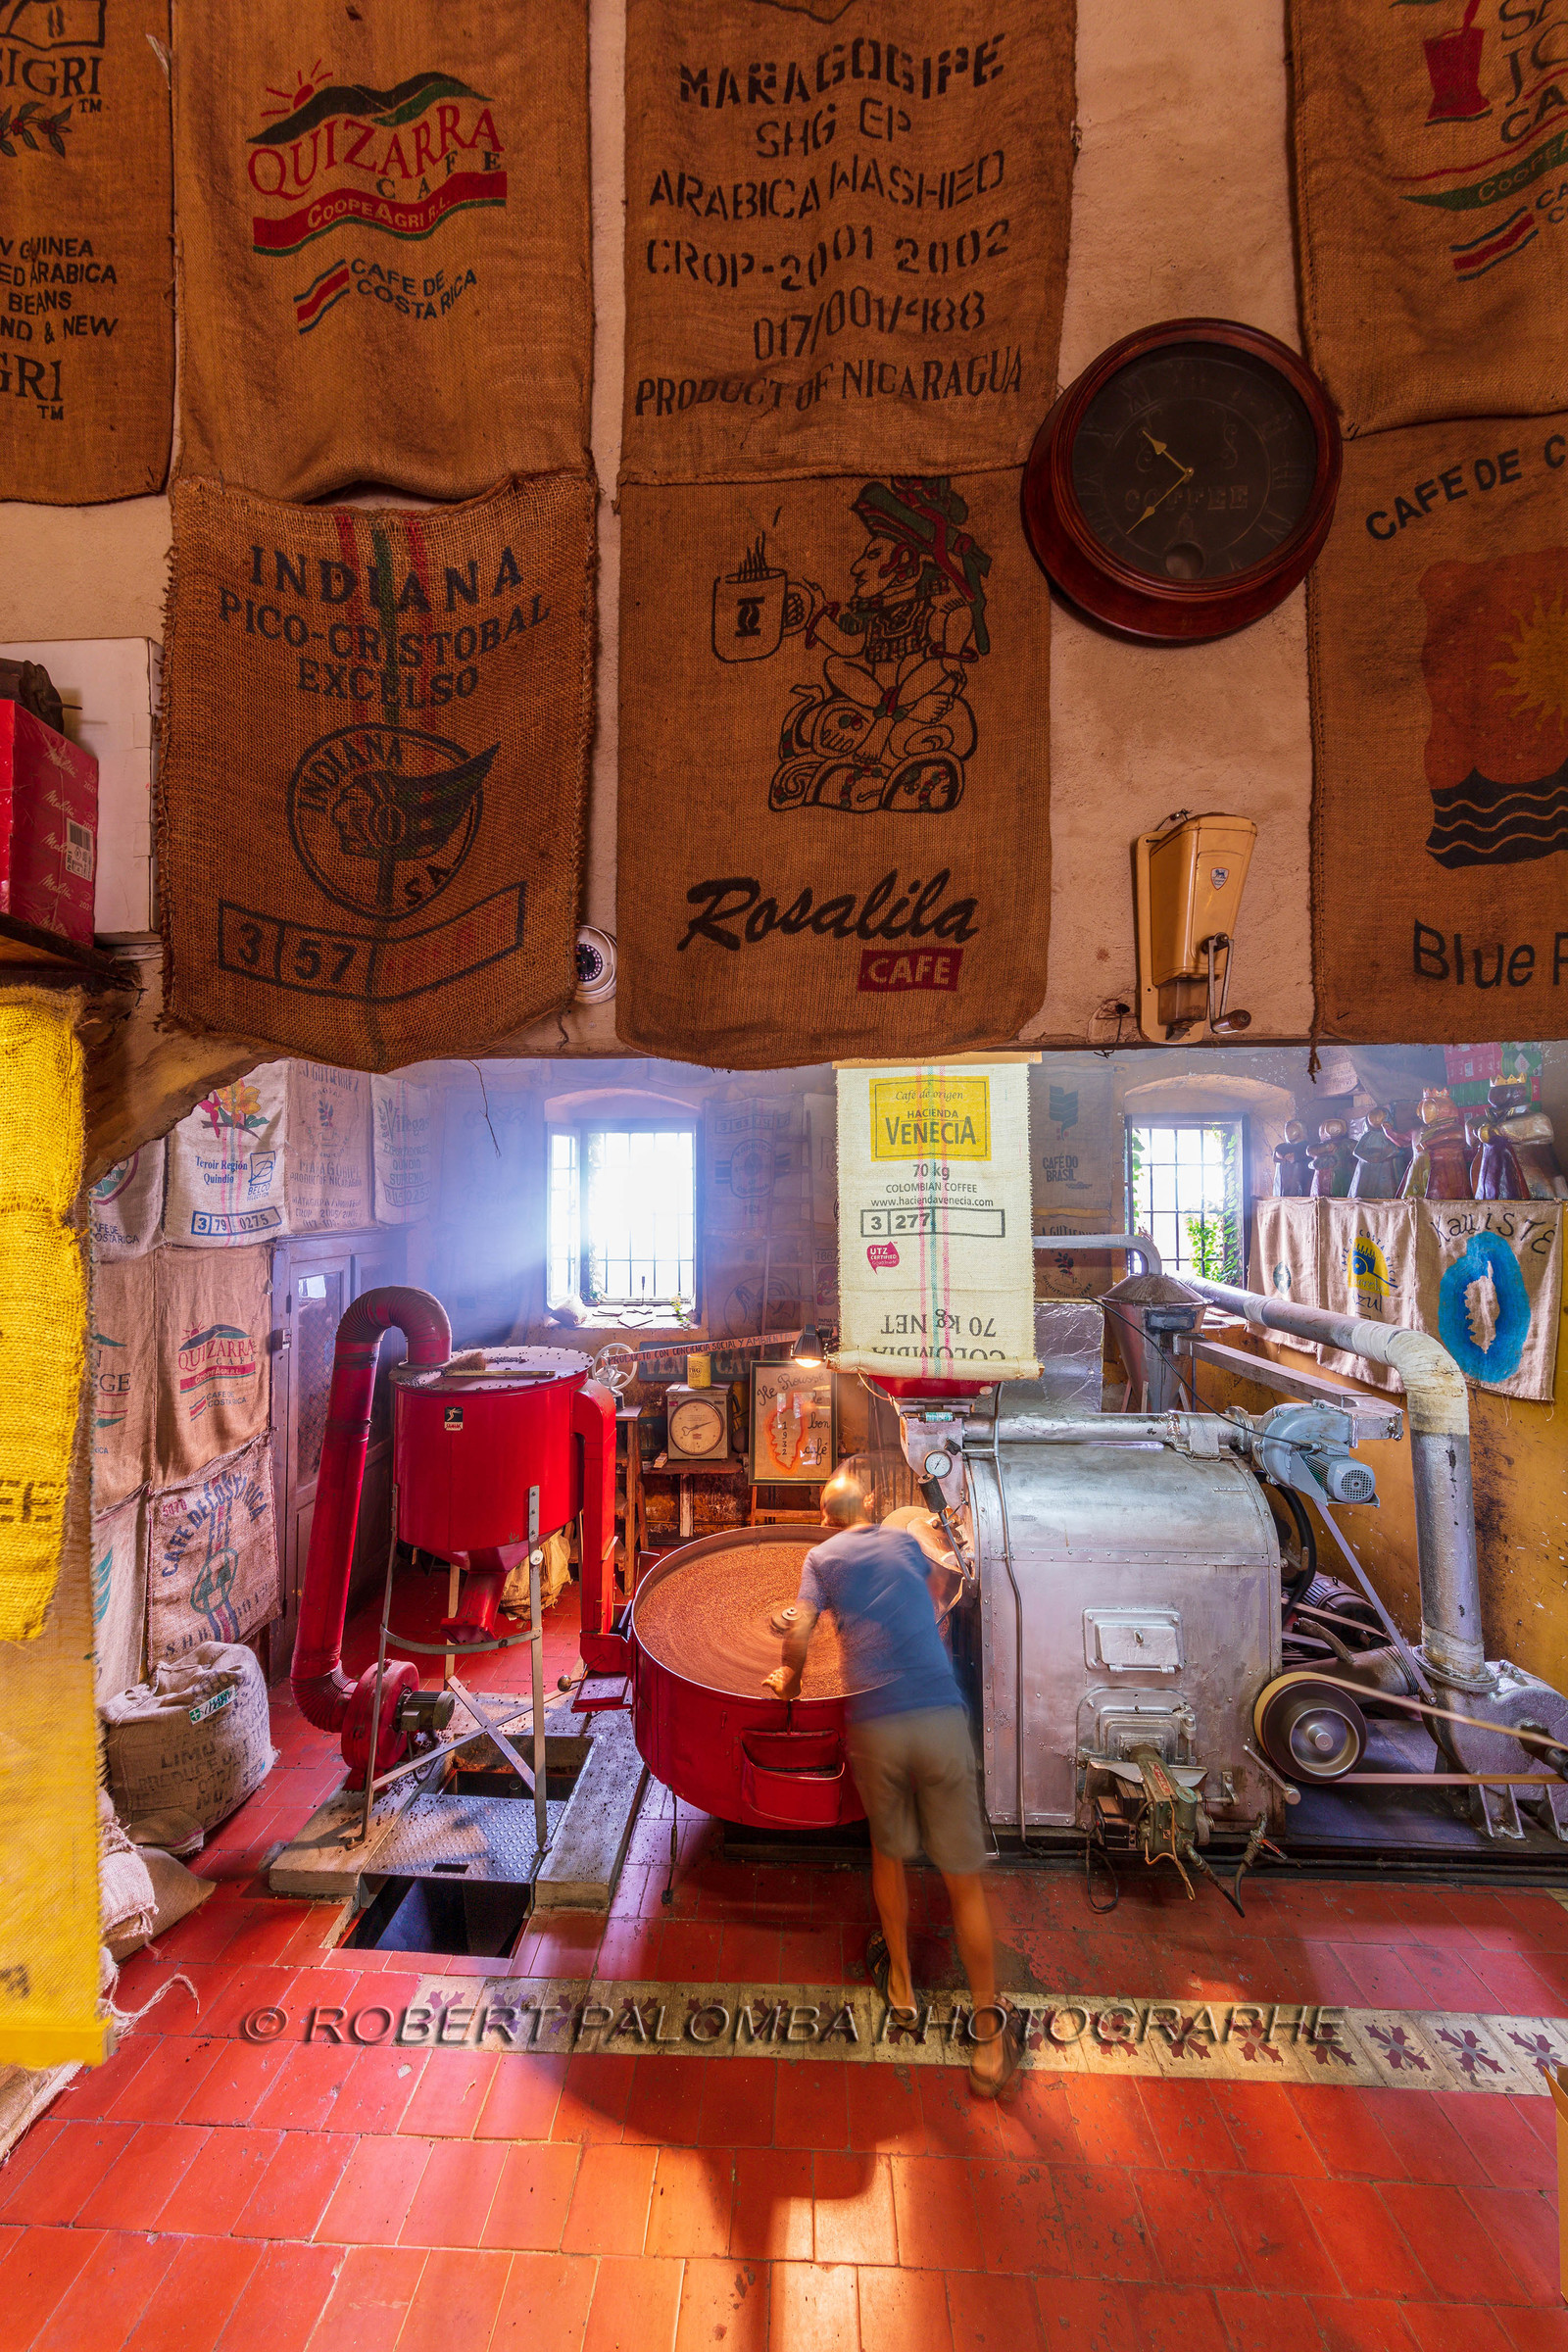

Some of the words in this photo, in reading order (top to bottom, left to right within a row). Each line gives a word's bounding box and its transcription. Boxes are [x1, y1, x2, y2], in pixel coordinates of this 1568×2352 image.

[0, 48, 103, 99] IGRI
[679, 32, 1006, 109] MARAGOGIPE
[757, 103, 837, 159] SHG
[858, 98, 912, 142] EP
[248, 104, 506, 201] QUIZARRA
[649, 170, 821, 221] ARABICA
[829, 149, 1005, 211] WASHED
[20, 236, 94, 260] GUINEA
[895, 219, 1010, 274] 2002
[30, 261, 118, 287] ARABICA
[351, 258, 416, 296] CAFE
[423, 269, 446, 298] DE
[8, 288, 73, 316] BEANS
[357, 278, 438, 320] COSTA
[440, 269, 478, 316] RICA
[63, 315, 120, 340] NEW
[635, 376, 790, 416] PRODUCT
[795, 362, 834, 413] OF
[841, 345, 1024, 402] NICARAGUA
[1125, 484, 1250, 513] COFFEE
[1365, 466, 1469, 542] CAFE
[1474, 449, 1523, 492] DE
[247, 544, 526, 615] INDIANA
[217, 592, 552, 670] PICO-CRISTOBAL
[298, 657, 480, 711] EXCELSO
[296, 732, 404, 814] INDIANA
[41, 789, 76, 818] Melitta
[39, 873, 73, 900] Melitta
[677, 867, 981, 953] Rosalila
[239, 922, 265, 966] 3
[295, 940, 359, 983] 57
[1412, 917, 1536, 990] Blue
[866, 954, 952, 986] CAFE
[895, 1089, 916, 1103] Café
[918, 1088, 931, 1099] de
[933, 1089, 963, 1102] origen
[906, 1108, 959, 1119] HACIENDA
[885, 1115, 977, 1146] VENECIA
[912, 1163, 929, 1178] 70
[933, 1161, 951, 1181] kg
[1042, 1152, 1065, 1170] CAFÉ
[1065, 1154, 1079, 1169] DO
[1046, 1168, 1077, 1183] BRASIL
[247, 1182, 270, 1196] BELCO
[870, 1195, 994, 1208] www.haciendavenecia.com
[885, 1182, 942, 1194] COLOMBIAN
[944, 1182, 978, 1194] COFFEE
[197, 1217, 208, 1231] 3
[239, 1213, 270, 1230] 0275
[870, 1215, 882, 1231] 3
[895, 1212, 932, 1230] 277
[869, 1247, 889, 1255] UTZ
[1359, 1229, 1386, 1252] COSTA
[880, 1313, 928, 1335] NET
[968, 1316, 997, 1338] 70
[177, 1338, 257, 1372] QUIZARRA
[607, 1350, 652, 1366] PRODUCTO
[654, 1348, 670, 1361] CON
[672, 1343, 710, 1357] CONCIENCIA
[711, 1340, 737, 1351] SOCIAL
[737, 1338, 744, 1348] Y
[206, 1391, 226, 1400] CAFE
[777, 1373, 824, 1392] Rousse
[808, 1411, 830, 1430] bon
[803, 1437, 829, 1466] café
[162, 1525, 195, 1578] CAFE
[186, 1499, 211, 1530] DE
[242, 1480, 268, 1523] RICA
